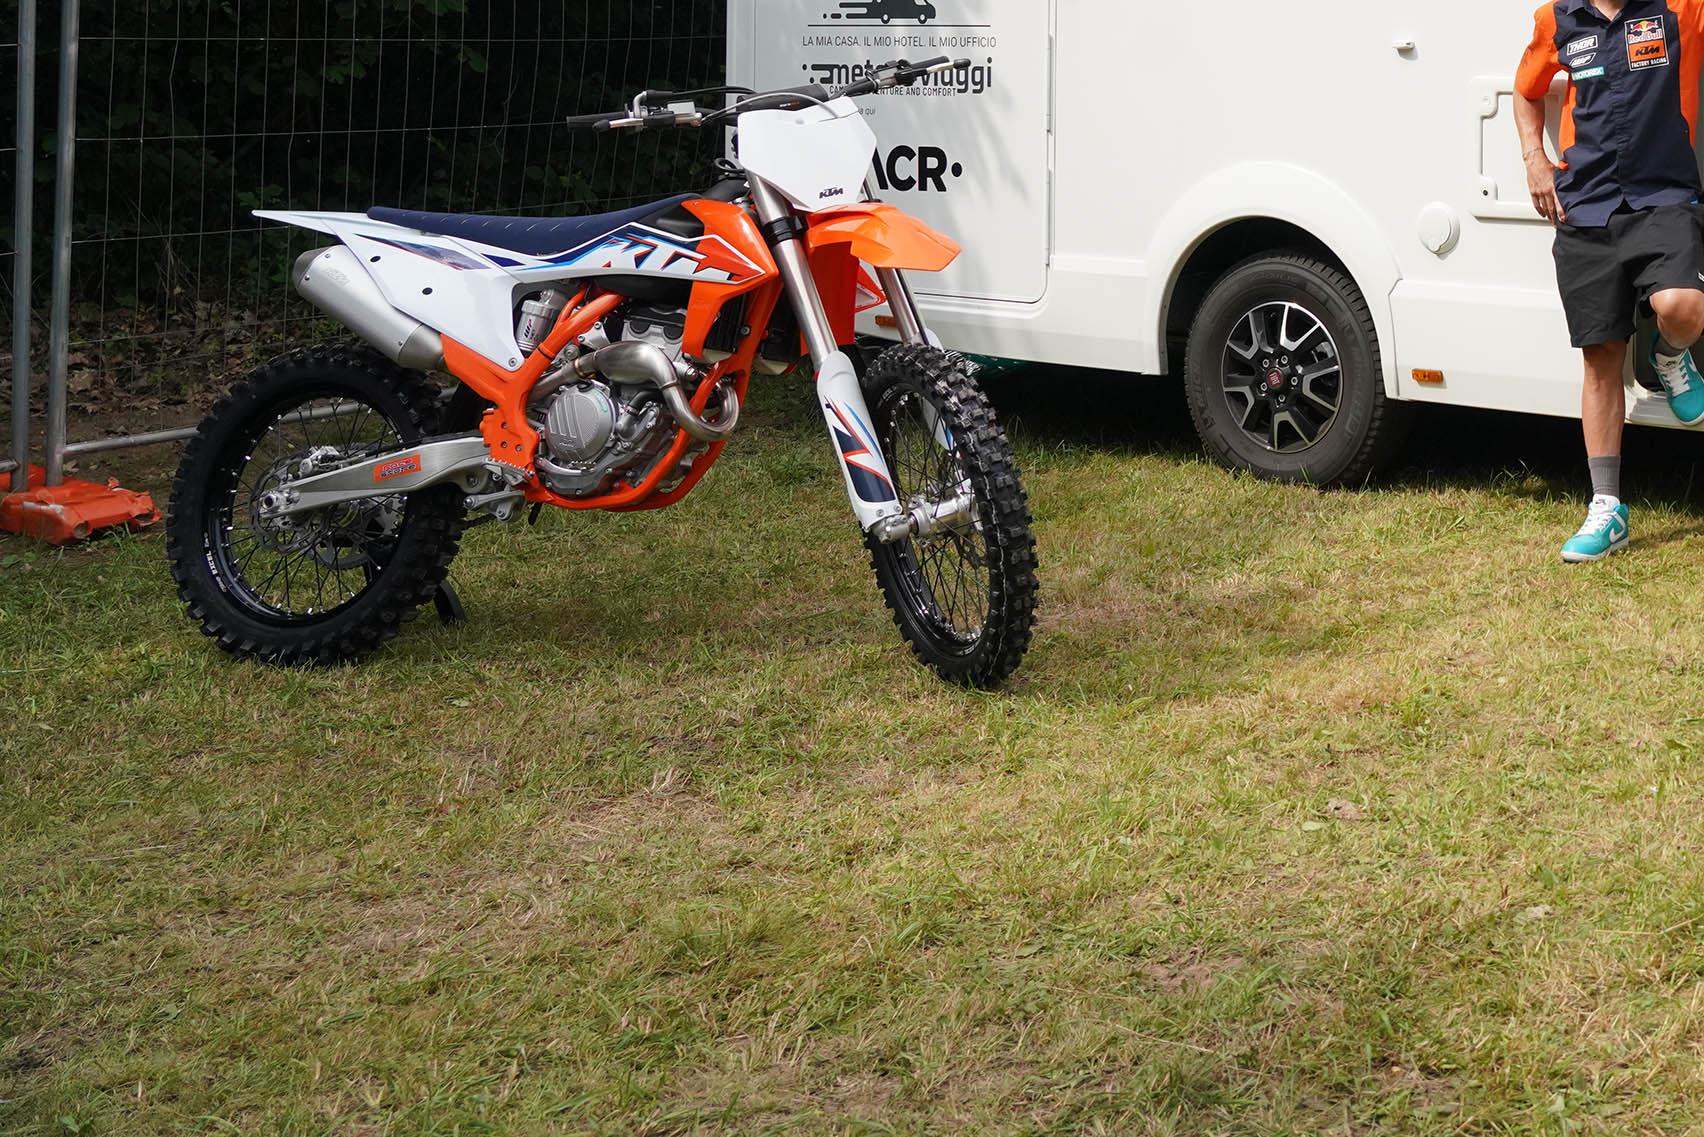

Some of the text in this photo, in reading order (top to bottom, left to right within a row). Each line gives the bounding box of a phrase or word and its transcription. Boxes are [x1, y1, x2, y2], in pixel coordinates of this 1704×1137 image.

[802, 35, 814, 47] LA
[816, 35, 833, 47] MIA
[864, 35, 872, 47] IL
[874, 35, 891, 47] MIO
[929, 36, 937, 48] IL
[940, 36, 957, 48] MIO
[960, 36, 997, 48] UFFICIO
[1569, 37, 1595, 53] THOR
[1635, 46, 1660, 56] KTM
[906, 87, 921, 96] AND
[922, 87, 956, 97] COMFORT
[818, 187, 844, 199] KTM
